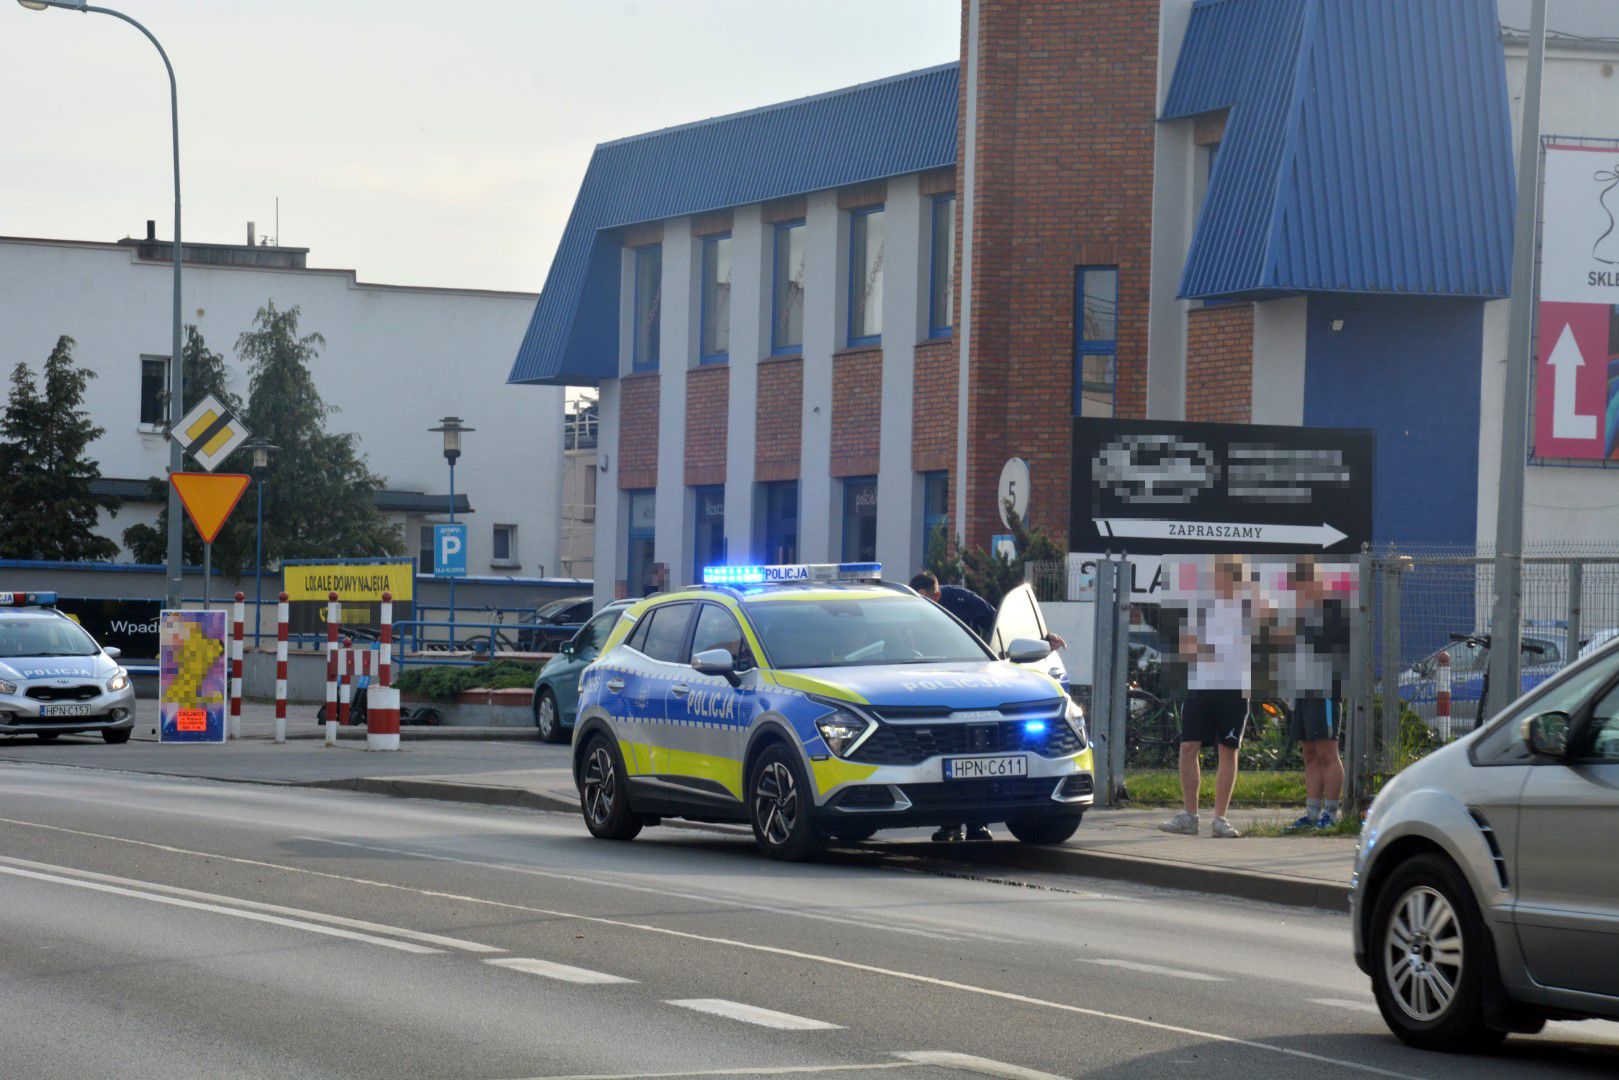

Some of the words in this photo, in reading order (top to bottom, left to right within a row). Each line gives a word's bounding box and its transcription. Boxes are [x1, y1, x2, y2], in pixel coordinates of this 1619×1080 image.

[1169, 524, 1262, 538] ZAPRASZAMY
[765, 567, 808, 579] POLICJA
[24, 668, 92, 678] POLICJA
[902, 679, 1013, 692] POLICJA
[45, 705, 66, 715] HPN
[686, 689, 735, 719] POLICJA
[955, 760, 983, 776] HPN
[988, 759, 1022, 775] C611
